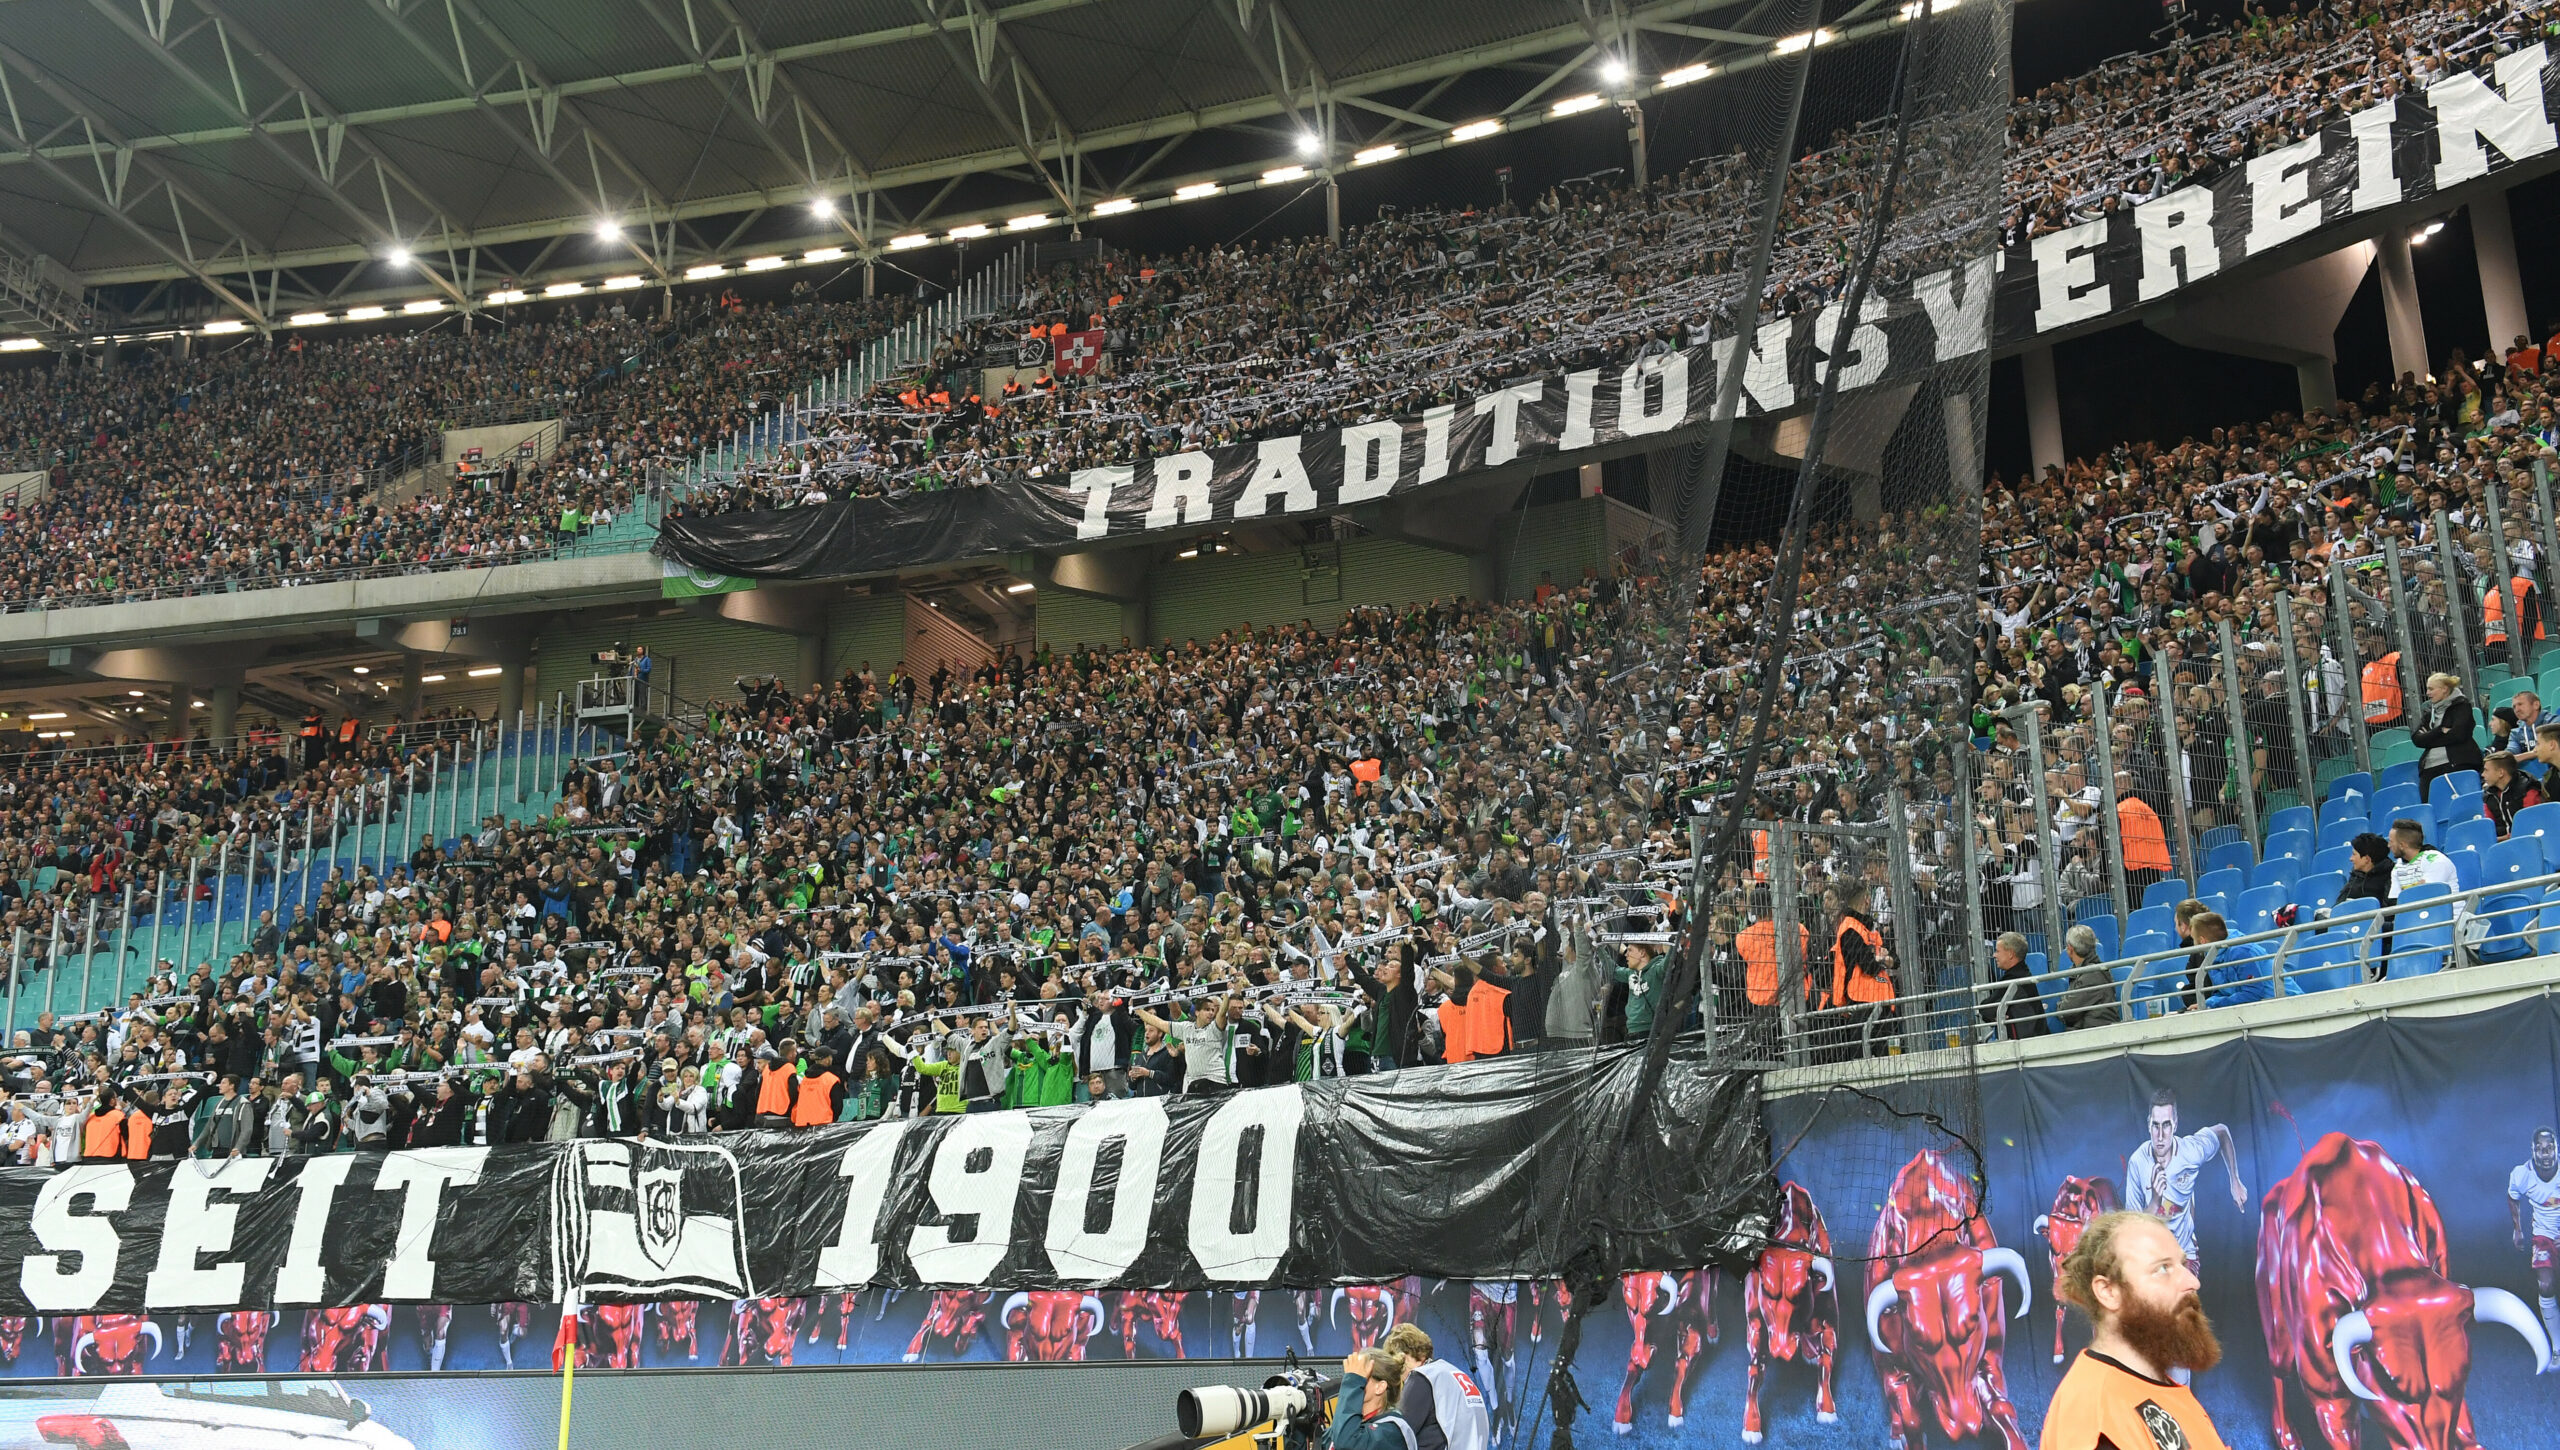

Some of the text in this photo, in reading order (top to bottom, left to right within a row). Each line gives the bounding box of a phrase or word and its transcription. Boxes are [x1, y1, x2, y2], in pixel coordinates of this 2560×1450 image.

[1068, 40, 2560, 542] TRADITIONSVEREIN
[20, 1082, 1303, 1311] SEIT 1900
